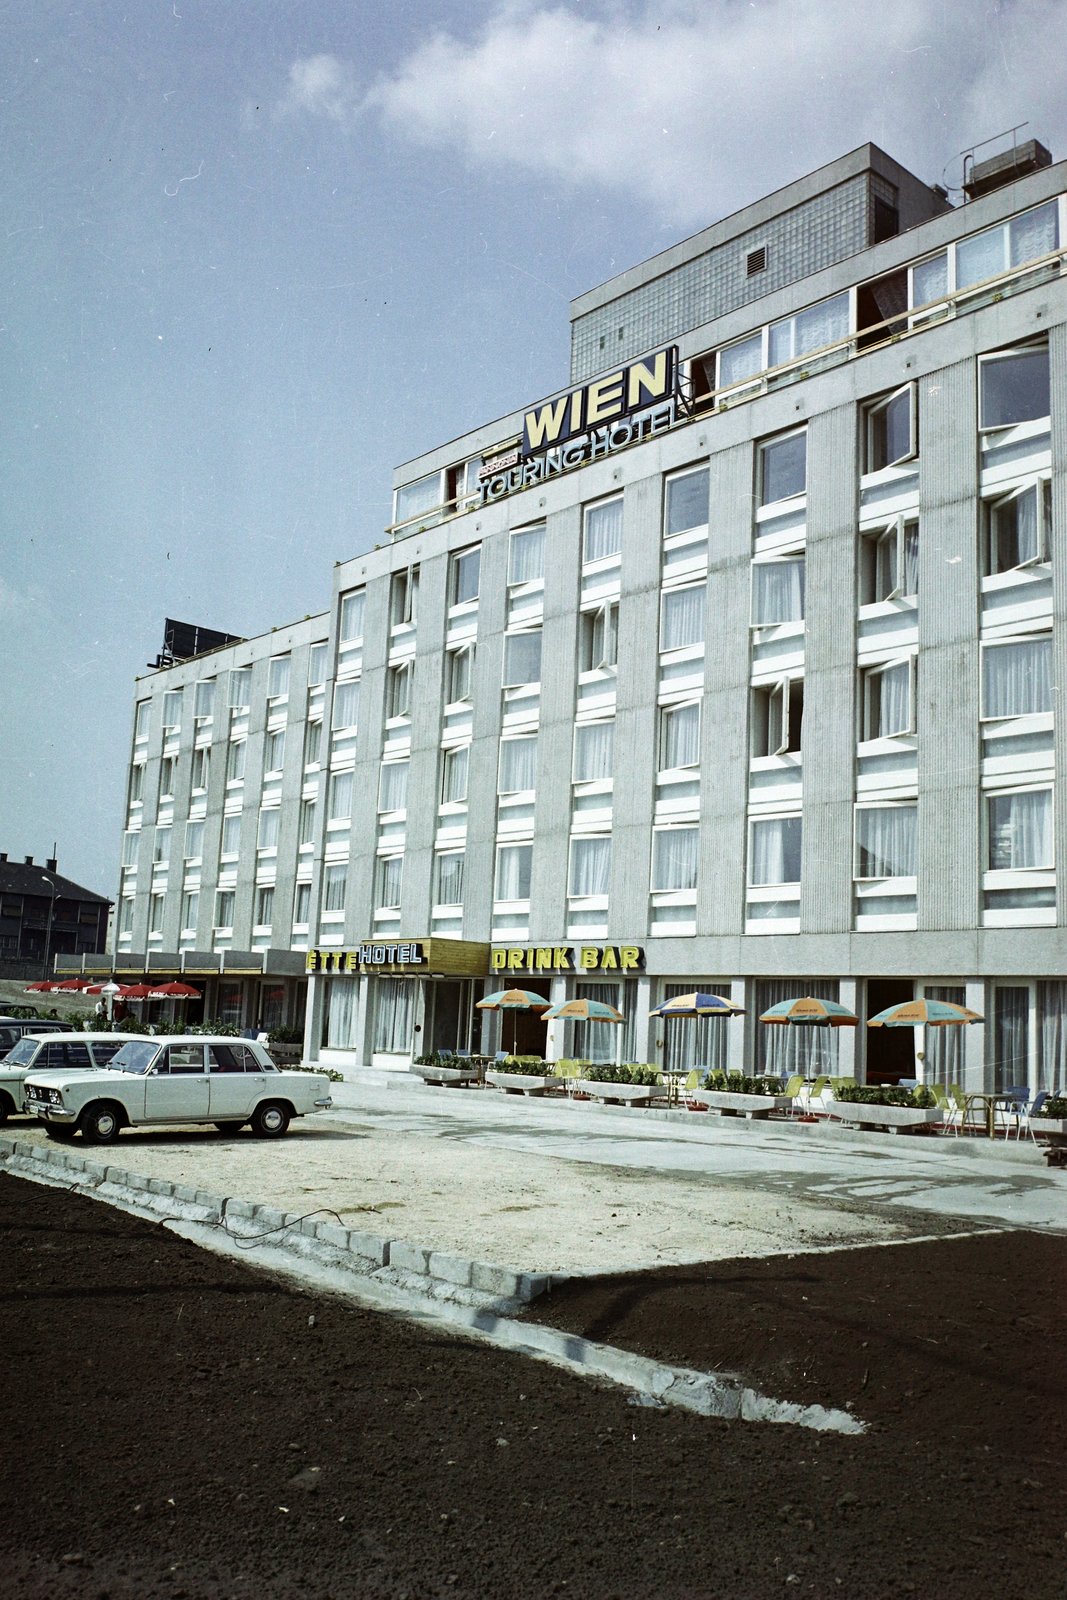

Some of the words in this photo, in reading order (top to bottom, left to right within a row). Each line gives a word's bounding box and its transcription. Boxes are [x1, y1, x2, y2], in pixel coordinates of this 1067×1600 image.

[525, 350, 667, 450] WIEN
[477, 444, 585, 500] TOURING
[591, 404, 687, 460] HOTEL
[359, 944, 422, 964] HOTEL
[491, 948, 570, 969] DRINK
[580, 946, 640, 968] BAR
